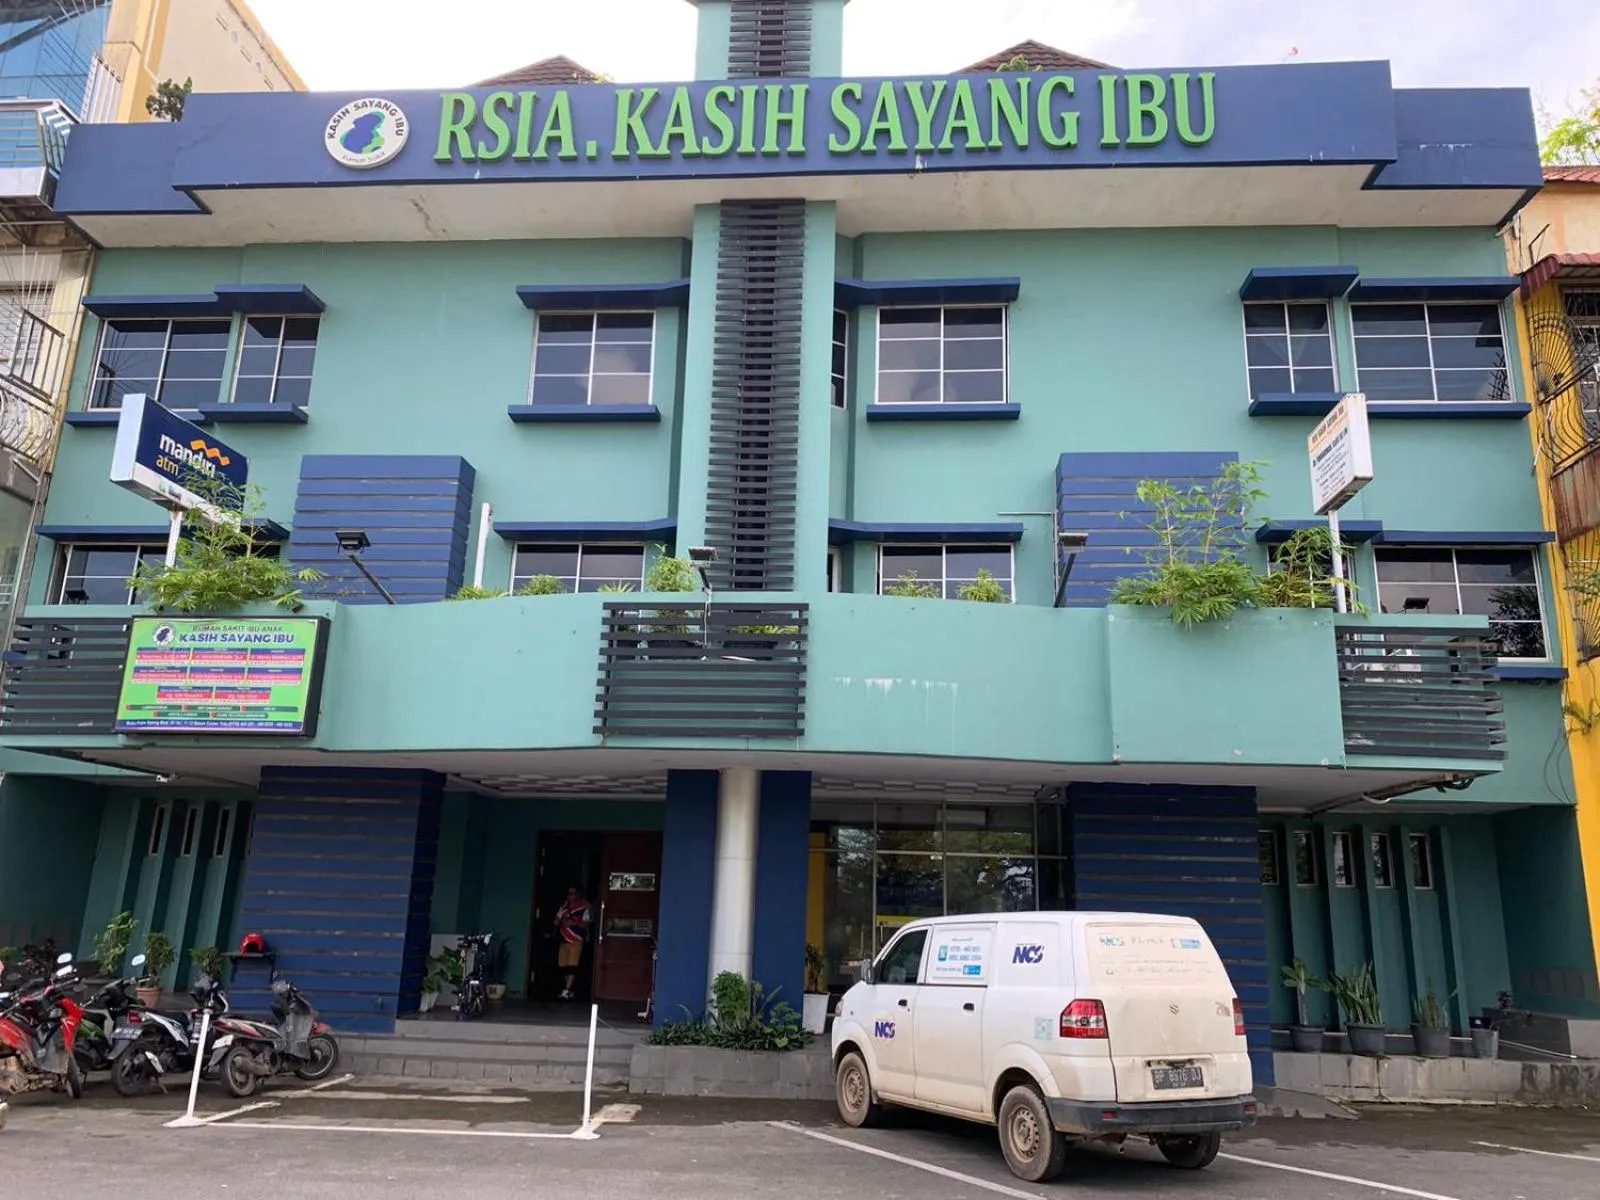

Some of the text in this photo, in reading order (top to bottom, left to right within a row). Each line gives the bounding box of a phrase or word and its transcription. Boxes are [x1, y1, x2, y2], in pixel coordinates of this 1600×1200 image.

[327, 99, 405, 140] KASIH SAYANG IBU
[434, 71, 1217, 163] RSIA. KASIH SAYANG IBU
[156, 454, 179, 476] atm
[160, 434, 216, 478] mandiri
[179, 633, 295, 644] KASIH SAYANG IBU
[1012, 945, 1044, 963] NCS
[875, 1021, 896, 1039] NCS
